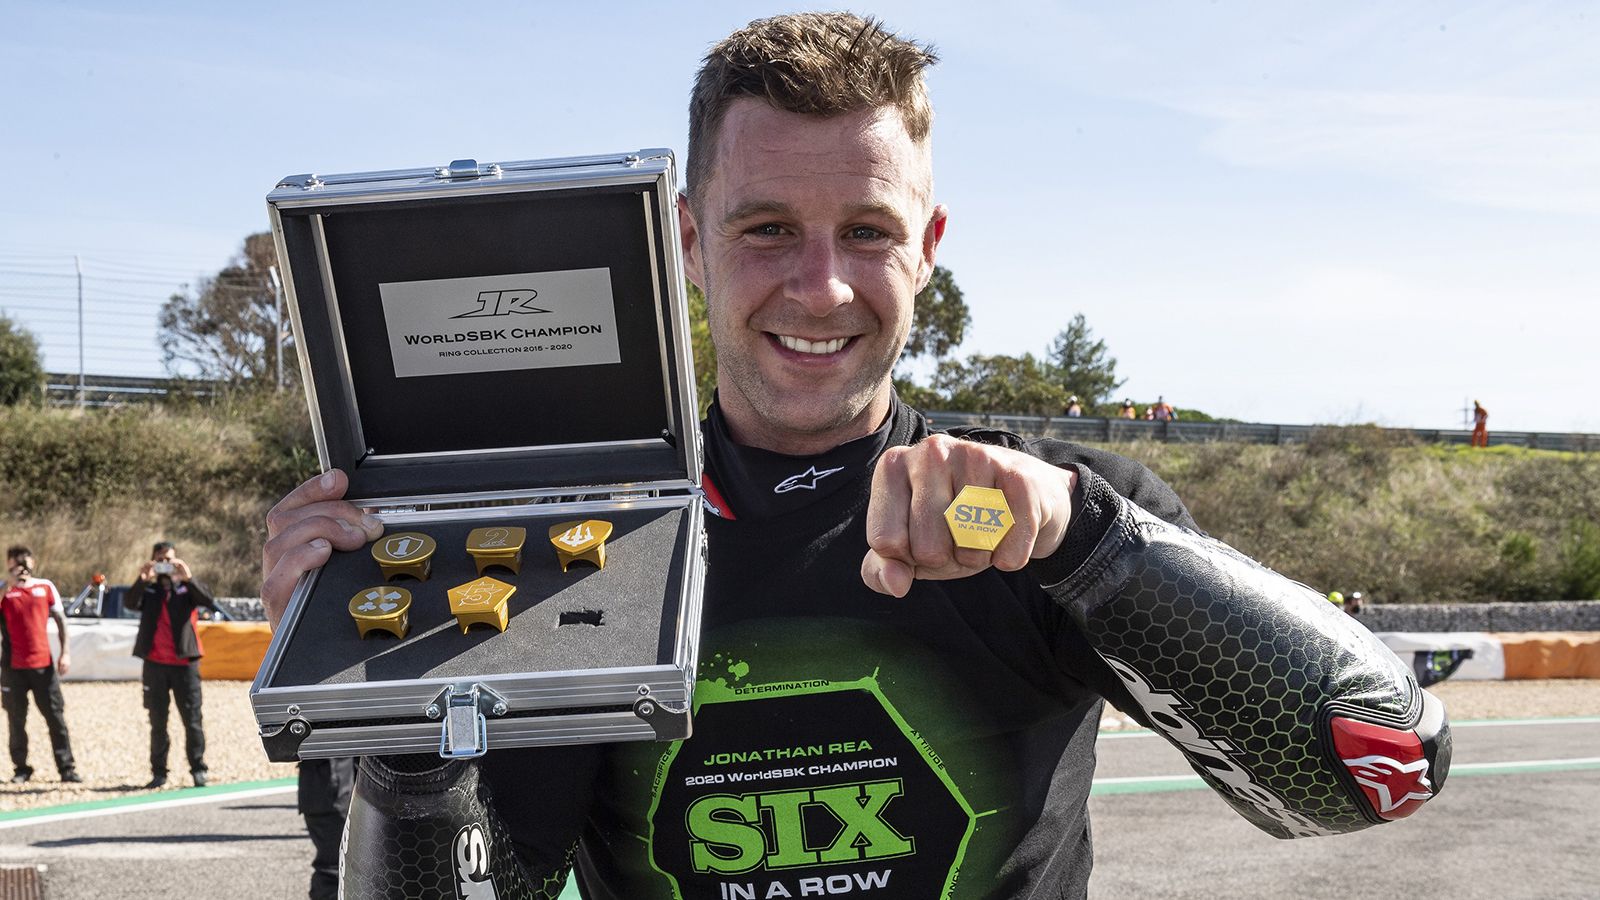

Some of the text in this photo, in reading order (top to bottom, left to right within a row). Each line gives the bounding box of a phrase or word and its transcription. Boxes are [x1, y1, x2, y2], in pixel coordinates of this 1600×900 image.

[510, 325, 602, 339] CHAMPION
[438, 350, 462, 358] RING
[463, 347, 522, 356] COLLECTION
[523, 345, 543, 353] 2015
[954, 504, 1006, 528] SIX
[393, 538, 411, 556] 1
[734, 680, 830, 695] DETERMINATION
[703, 740, 873, 766] JONATHAN REA
[910, 730, 946, 771] ATTITUDE
[652, 748, 673, 799] SACRIFICE
[685, 756, 899, 787] 2020 WorldSBK CHAMPION
[685, 777, 917, 875] SIX
[720, 869, 892, 900] IN A ROW
